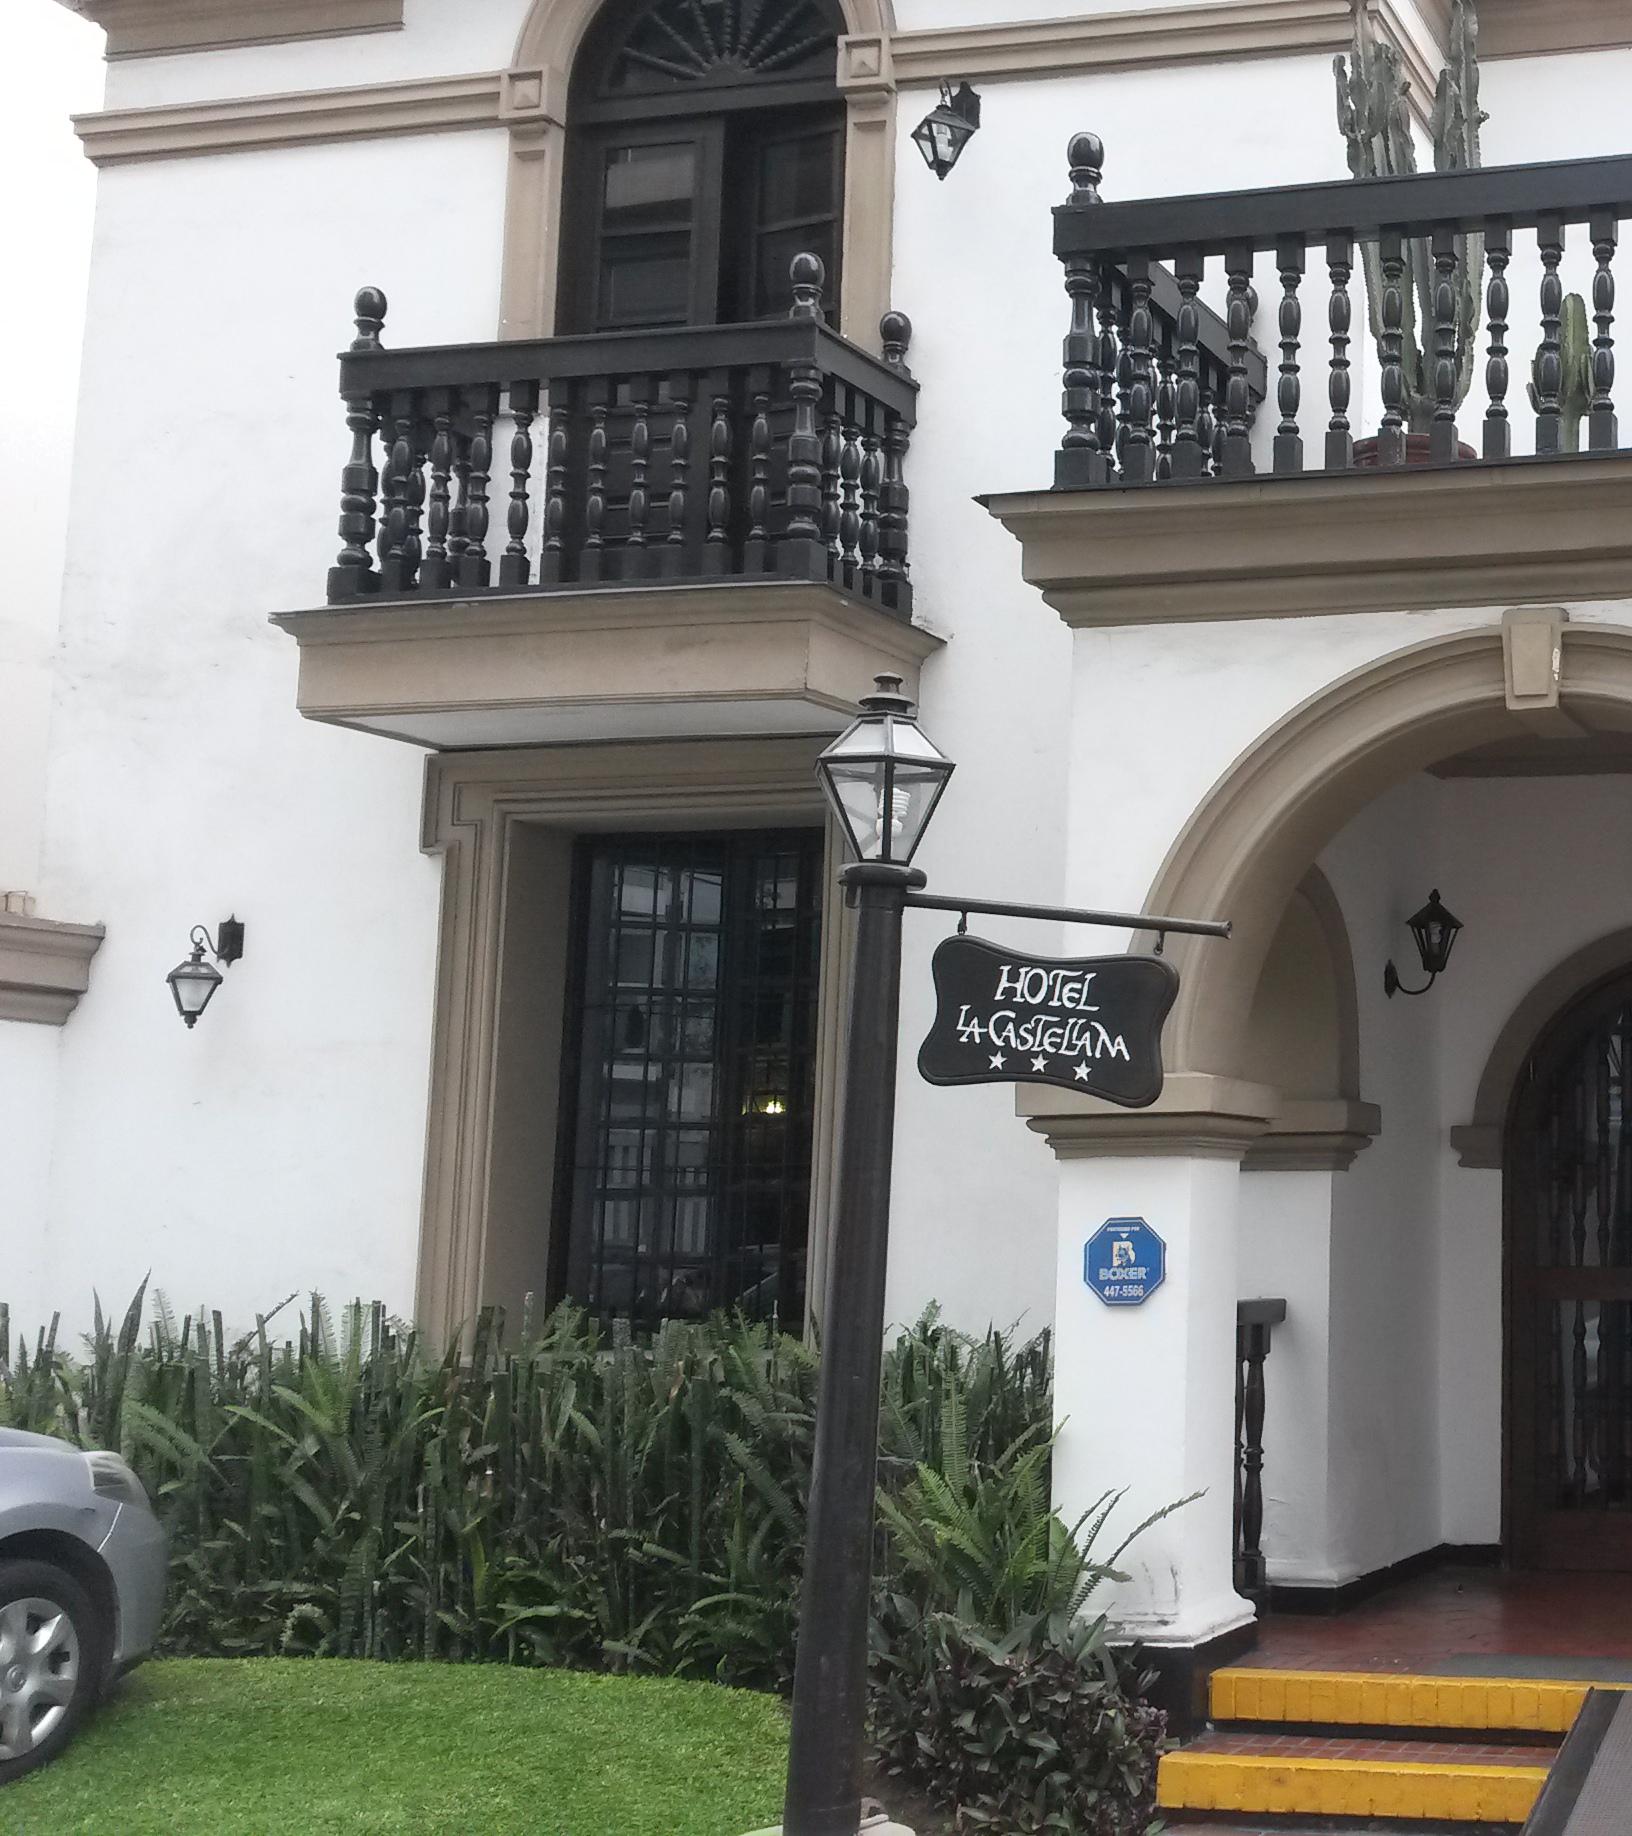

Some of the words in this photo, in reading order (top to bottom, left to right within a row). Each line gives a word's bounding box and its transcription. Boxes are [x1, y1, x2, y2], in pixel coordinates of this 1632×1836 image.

[994, 965, 1100, 1012] HOTEL
[956, 1004, 987, 1044] LA
[988, 1010, 1131, 1062] CASTELLANA
[1099, 1267, 1147, 1281] BOXER
